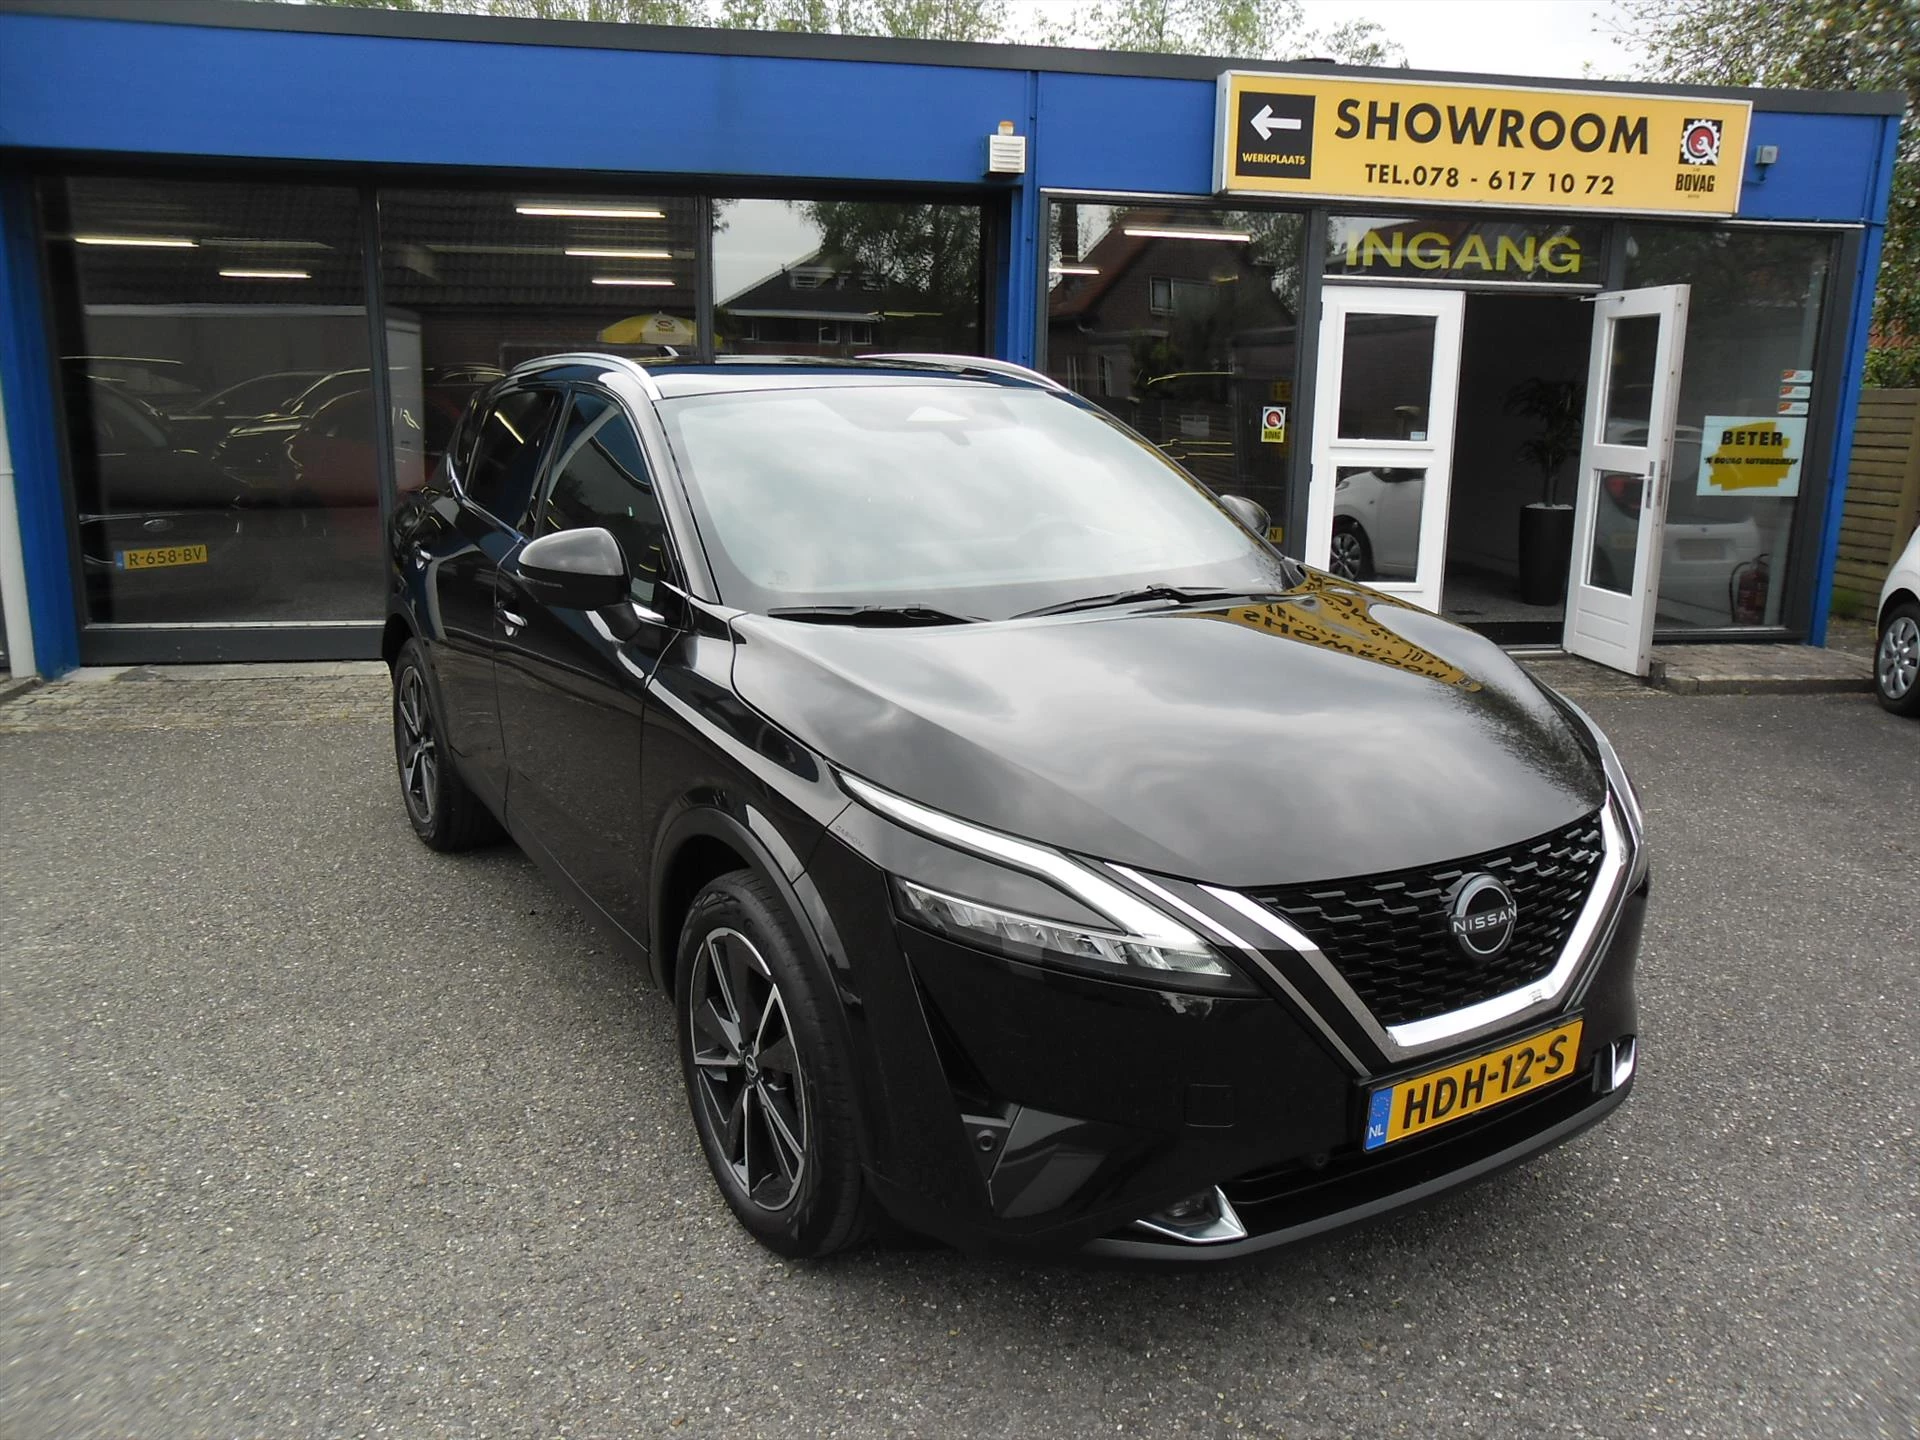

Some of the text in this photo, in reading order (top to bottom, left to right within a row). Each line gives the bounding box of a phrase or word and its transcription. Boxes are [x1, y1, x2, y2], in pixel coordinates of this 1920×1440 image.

[1335, 99, 1649, 155] SHOWROOM
[1242, 152, 1306, 165] WERKPLAATS
[1365, 163, 1459, 188] TEL.078
[1489, 170, 1539, 192] 617
[1548, 173, 1575, 194] 10
[1585, 174, 1615, 196] 72
[1675, 173, 1716, 192] BOVAG
[1345, 231, 1582, 274] INGANG
[1721, 430, 1783, 446] BETER
[128, 547, 202, 566] R-658-BV
[1452, 905, 1518, 934] NISSAN
[1401, 1034, 1568, 1130] HDH-12-S
[1368, 1124, 1385, 1140] NL
